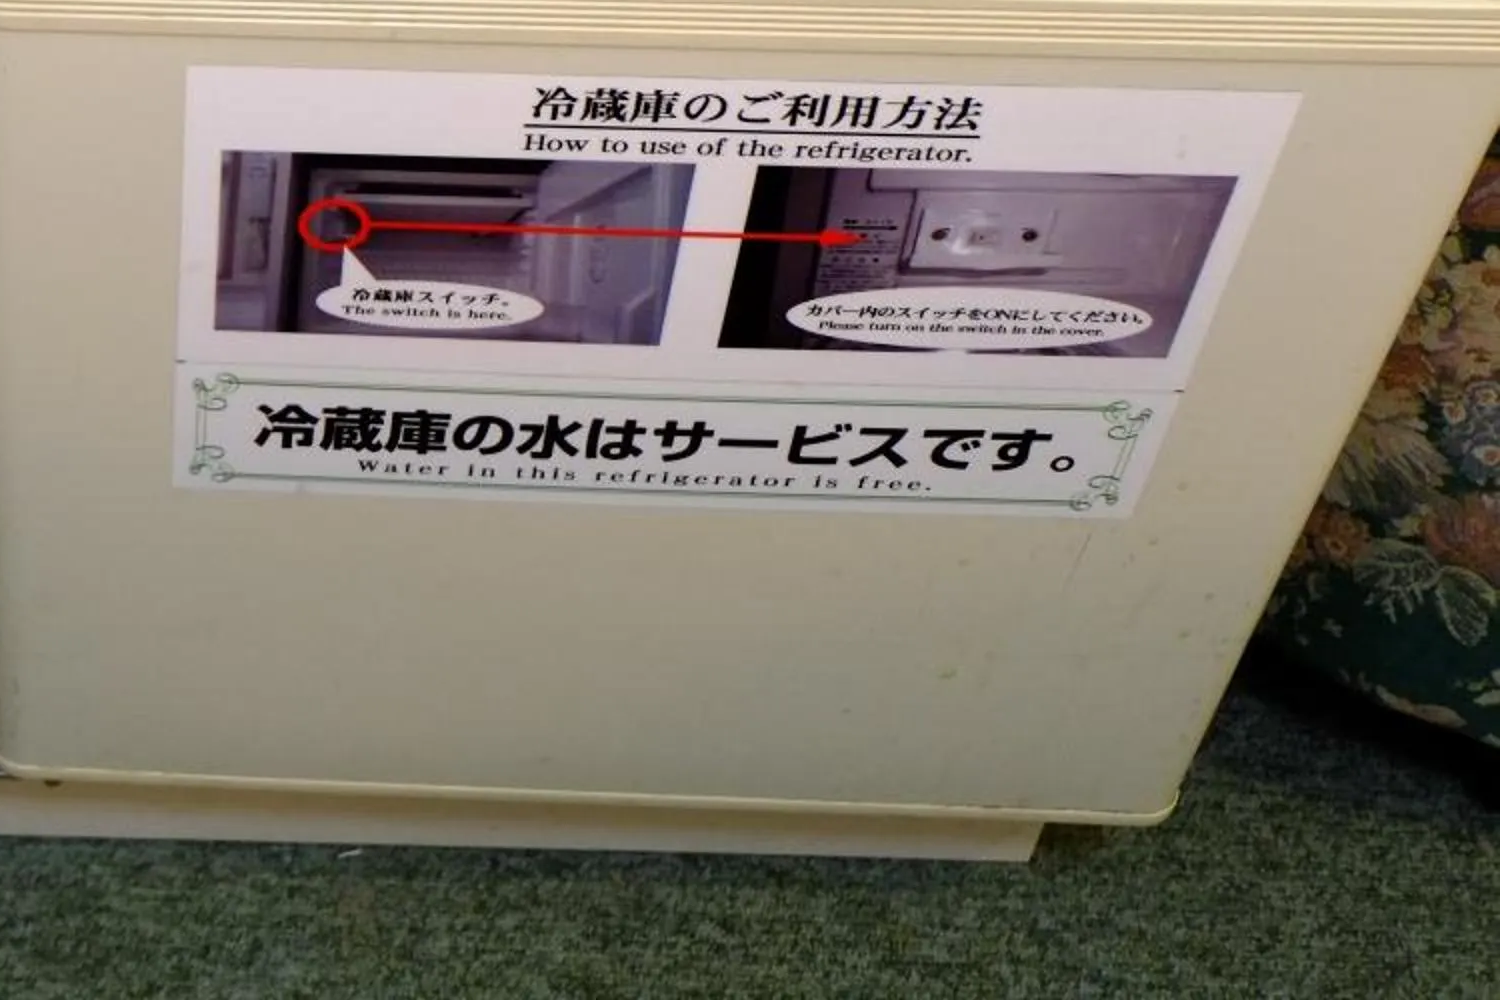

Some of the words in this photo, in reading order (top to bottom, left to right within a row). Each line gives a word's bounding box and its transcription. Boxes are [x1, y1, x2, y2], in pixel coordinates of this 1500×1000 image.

[531, 86, 983, 132] 冷蔵庫のご利用方法
[524, 133, 590, 152] How
[601, 136, 628, 153] to
[640, 140, 687, 155] use
[697, 137, 728, 156] of
[738, 139, 783, 158] the
[793, 140, 973, 163] refrigerator.
[352, 287, 510, 307] 冷蔵庫スイッチ。
[342, 305, 375, 315] The
[381, 307, 440, 318] switch
[447, 309, 461, 319] is
[467, 309, 512, 320] here.
[819, 321, 864, 330] Please
[869, 322, 901, 331] turn
[929, 322, 953, 332] the
[957, 324, 1007, 334] switch
[1012, 325, 1027, 334] in
[1031, 325, 1056, 335] the
[1060, 328, 1104, 336] cover.
[254, 403, 1076, 473] 冷蔵庫の水はサービスです。
[357, 459, 451, 475] Water
[468, 463, 496, 478] in
[516, 466, 577, 481] this
[595, 469, 796, 488] refrigerator
[813, 474, 838, 488] is
[856, 475, 933, 491] free.
